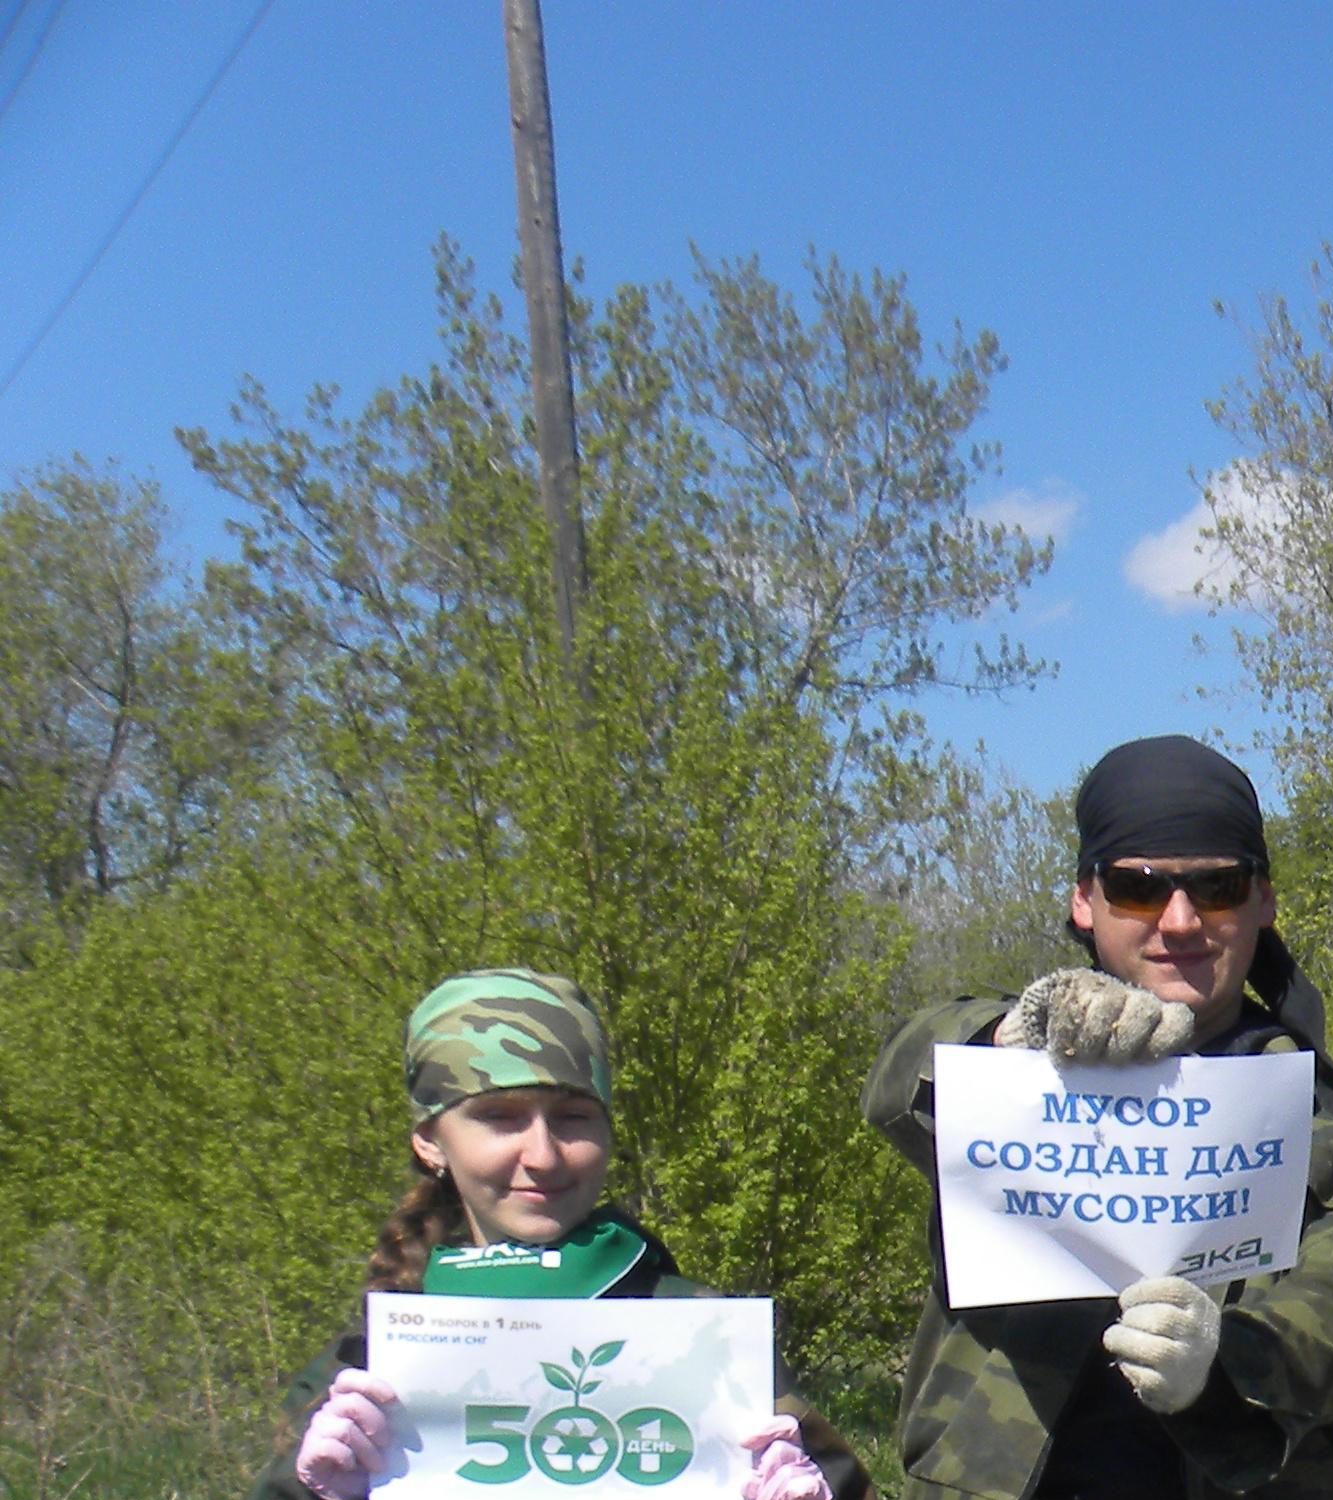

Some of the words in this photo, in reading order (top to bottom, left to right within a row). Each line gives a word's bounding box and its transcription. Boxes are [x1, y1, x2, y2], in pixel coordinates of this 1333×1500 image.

[1042, 1092, 1212, 1127] МУСОР
[966, 1139, 1168, 1178] СОЗДАН
[1184, 1138, 1285, 1180] ДЛЯ
[1002, 1188, 1250, 1224] МУСОРКИ!
[388, 1312, 425, 1326] 500
[495, 1317, 505, 1329] 1
[509, 1321, 543, 1331] ДЕНЬ
[398, 1334, 449, 1344] РОССИИ
[464, 1336, 489, 1345] СНГ
[626, 1439, 676, 1454] ДЕНЬ
